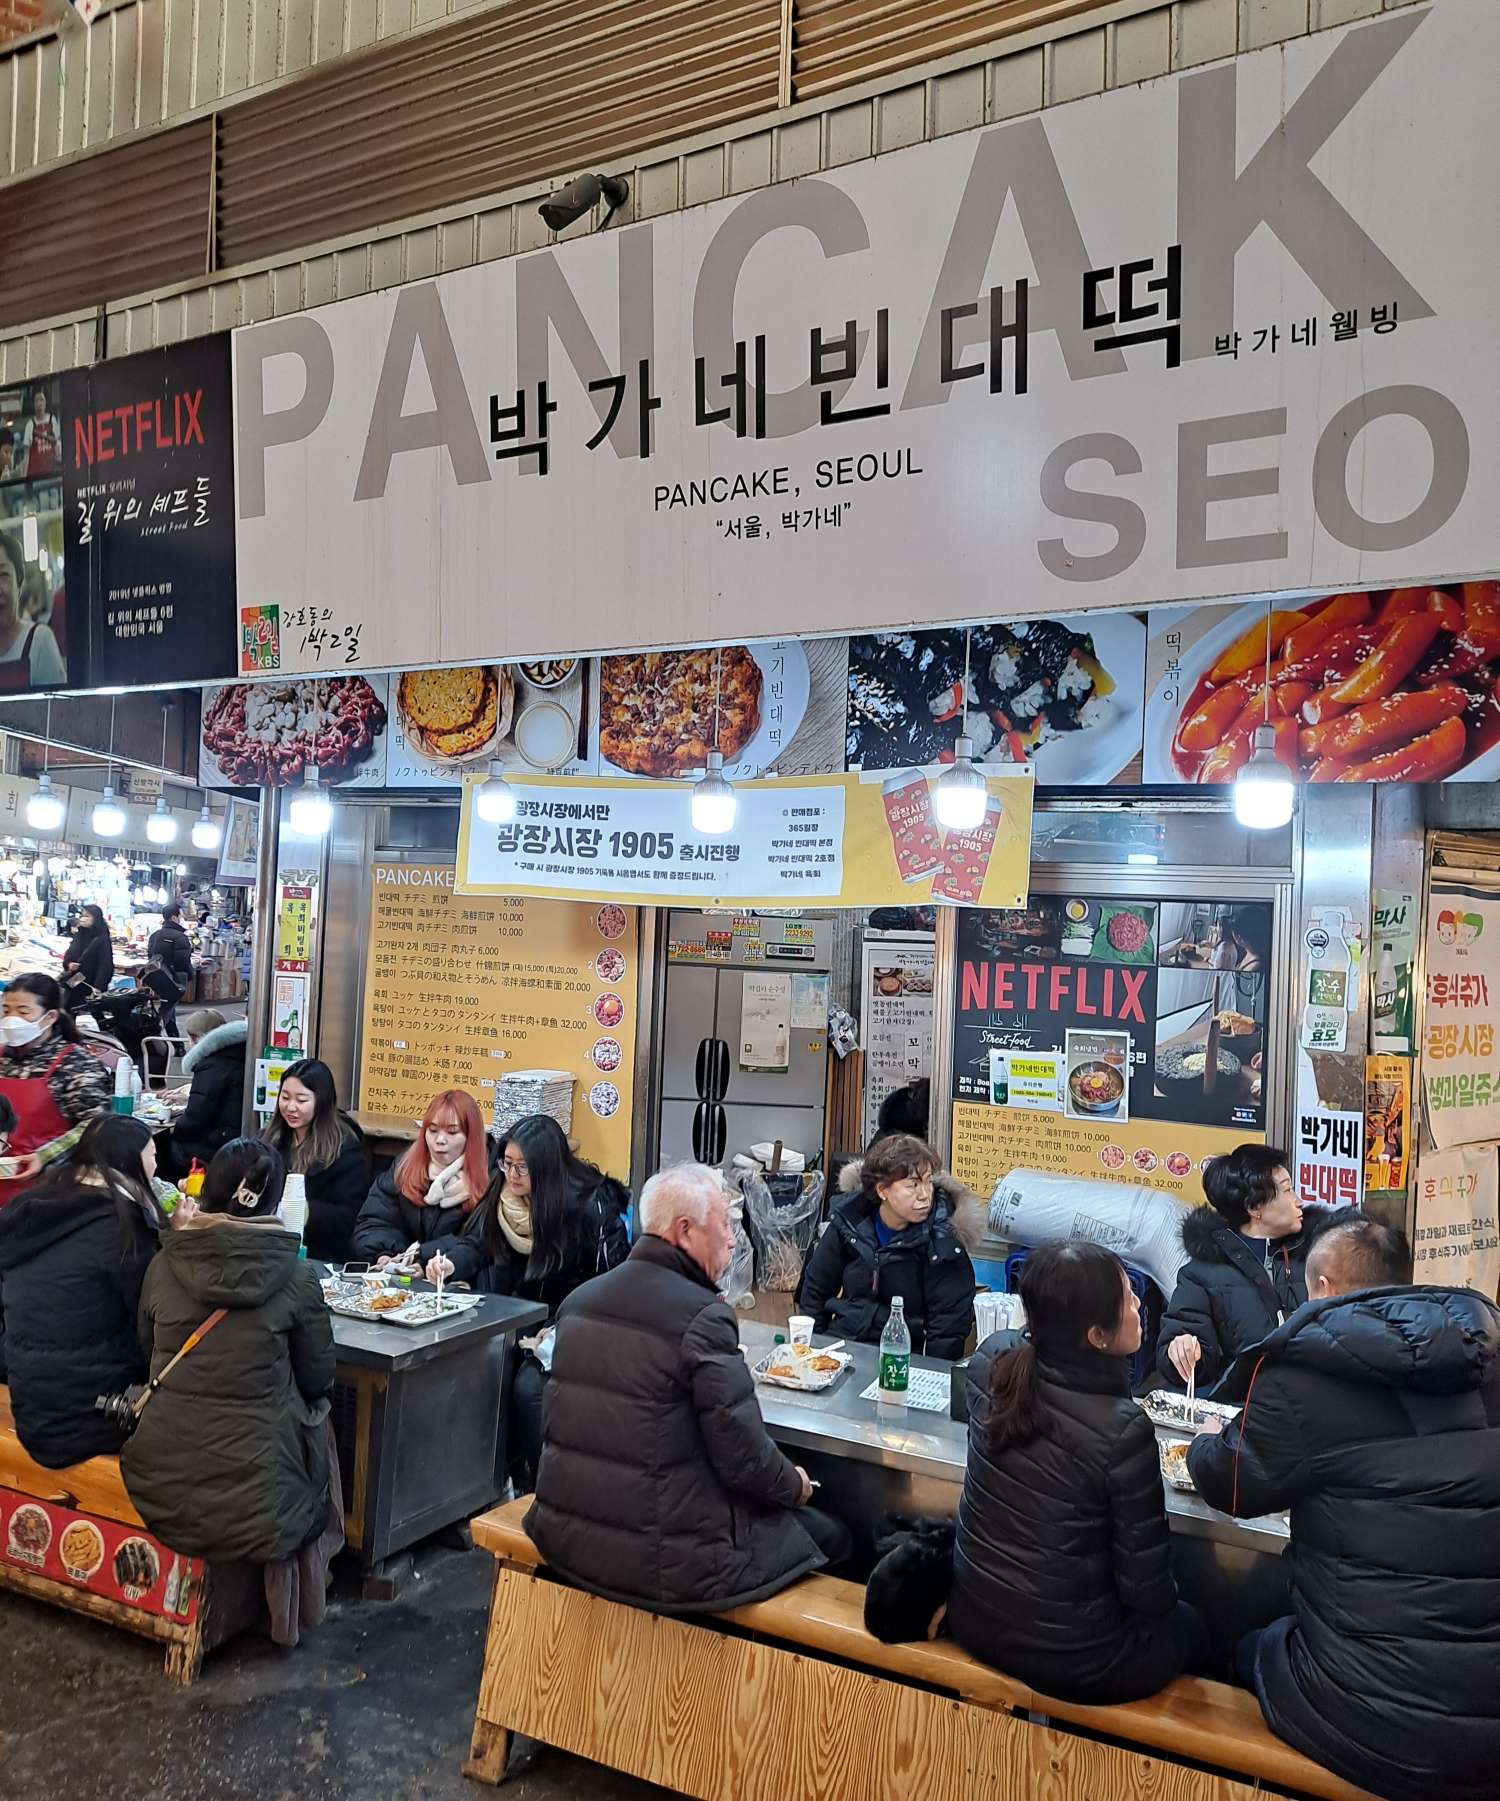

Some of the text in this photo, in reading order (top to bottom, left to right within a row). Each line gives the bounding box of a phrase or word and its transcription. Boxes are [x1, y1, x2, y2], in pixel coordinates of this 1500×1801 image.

[1213, 302, 1399, 360] 박가네웰빙
[74, 388, 206, 468] NETFLIX
[654, 447, 924, 512] PANCAKE, SEOUL
[1037, 384, 1470, 583] SEO
[103, 497, 142, 532] 위의
[715, 501, 853, 541] “서울, 박가네”
[283, 606, 333, 629] 강호동의
[299, 623, 363, 664] 1박2일
[256, 655, 280, 668] KBS
[1163, 631, 1182, 708] 떡볶이
[516, 800, 610, 821] 광장시장에서만
[903, 813, 925, 829] 1905
[497, 823, 741, 862] 광장시장 1905 출시진행
[771, 838, 794, 848] 박가네
[959, 838, 983, 852] 1905
[768, 854, 790, 863] 박가네
[375, 867, 455, 887] PANCAKE
[545, 864, 575, 874] 광장시장
[576, 866, 594, 876] 1905
[780, 870, 804, 879] 박가네
[502, 897, 525, 908] 5,000
[498, 912, 524, 923] 10,000
[1374, 905, 1407, 928] 막사
[498, 926, 524, 938] 10,000
[478, 946, 499, 956] 6,000
[564, 981, 591, 992] 20,000
[1315, 977, 1341, 993] 장수
[960, 960, 1148, 1025] NETFLIX
[454, 996, 479, 1006] 19,000
[1376, 992, 1395, 1008] 막사
[560, 1019, 588, 1030] 32,000
[501, 1029, 527, 1040] 16,000
[1310, 1029, 1337, 1042] 효모
[452, 1060, 473, 1070] 7,000
[1033, 1114, 1055, 1124] 5,000
[1083, 1132, 1110, 1143] 10,000
[1301, 1115, 1359, 1159] 박가네
[1065, 1143, 1092, 1154] 10,000
[1041, 1153, 1068, 1164] 19,000
[1154, 1178, 1183, 1190] 32,000
[1299, 1163, 1358, 1206] 빈대떡
[887, 1363, 908, 1377] 장수
